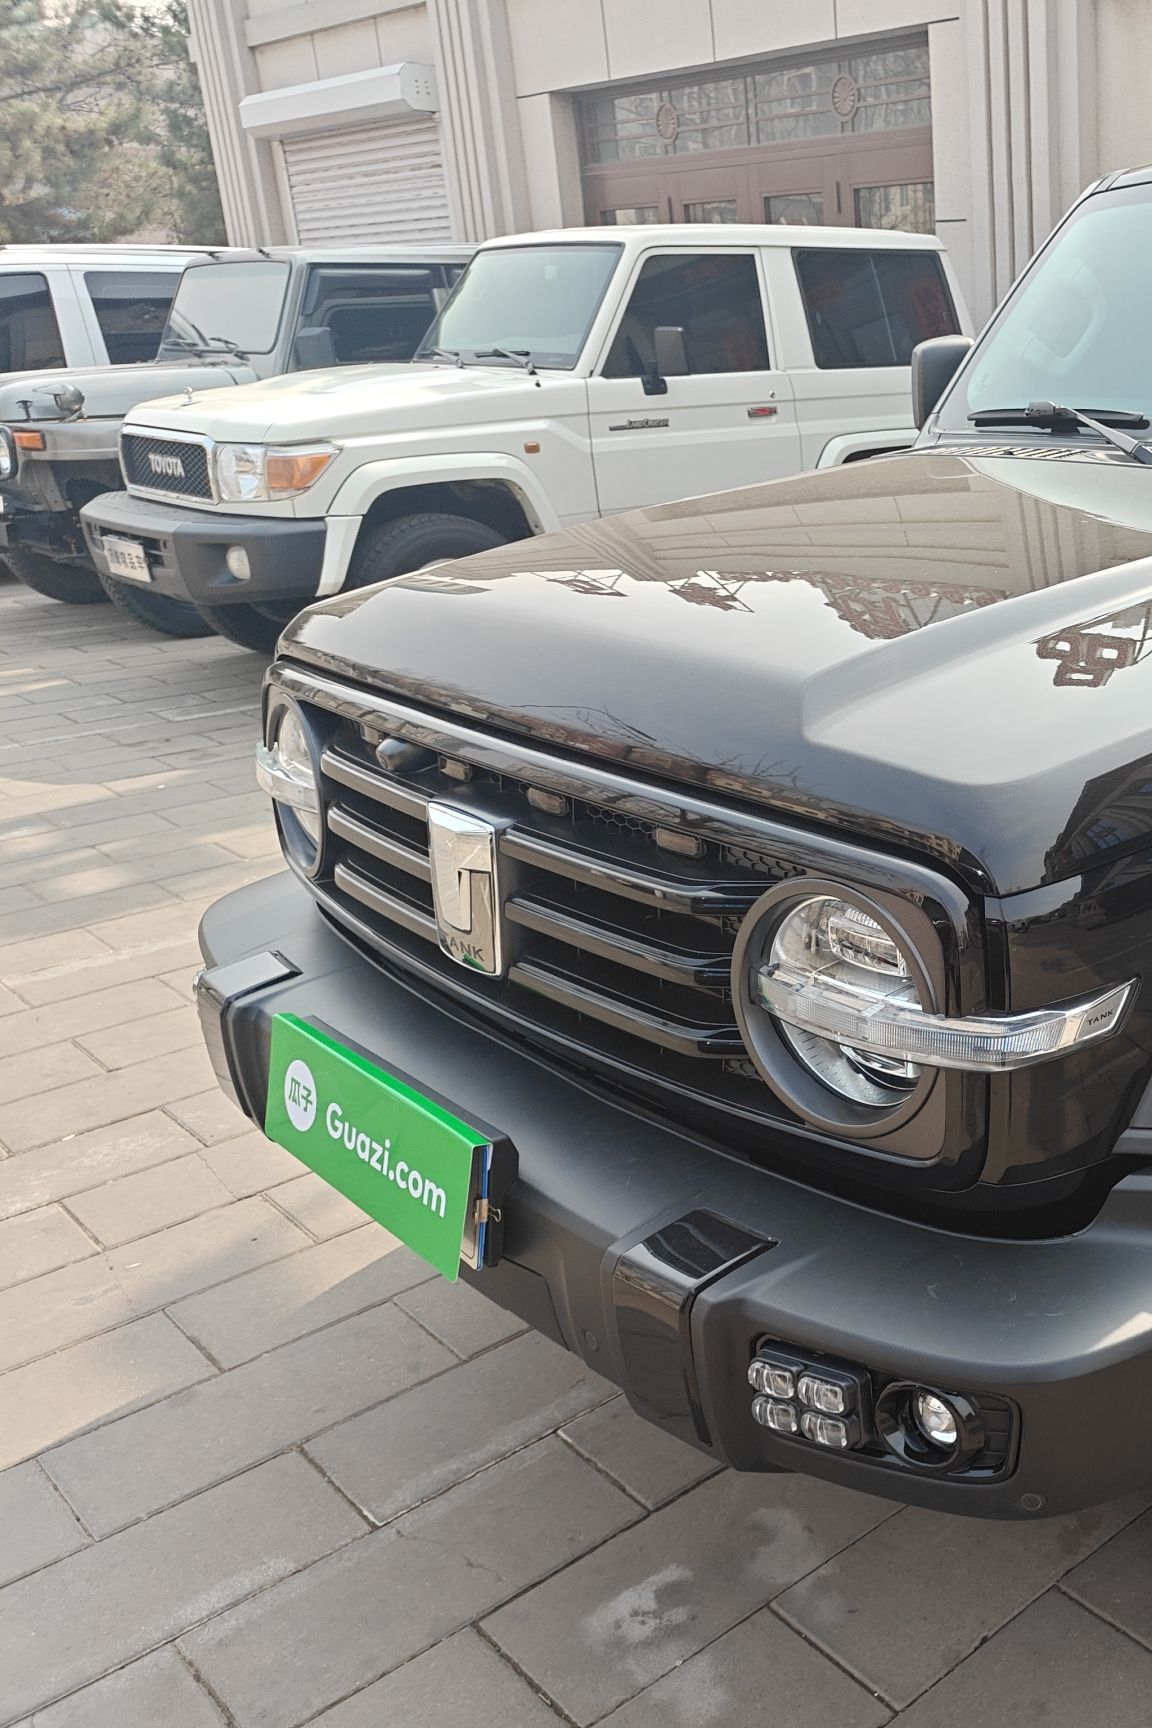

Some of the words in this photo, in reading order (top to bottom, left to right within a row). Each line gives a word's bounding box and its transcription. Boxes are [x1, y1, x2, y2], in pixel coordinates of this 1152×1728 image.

[148, 453, 185, 478] TOYOTA
[1087, 1009, 1114, 1026] TANK
[288, 1076, 314, 1113] 瓜子
[326, 1102, 447, 1218] Guazi.com
